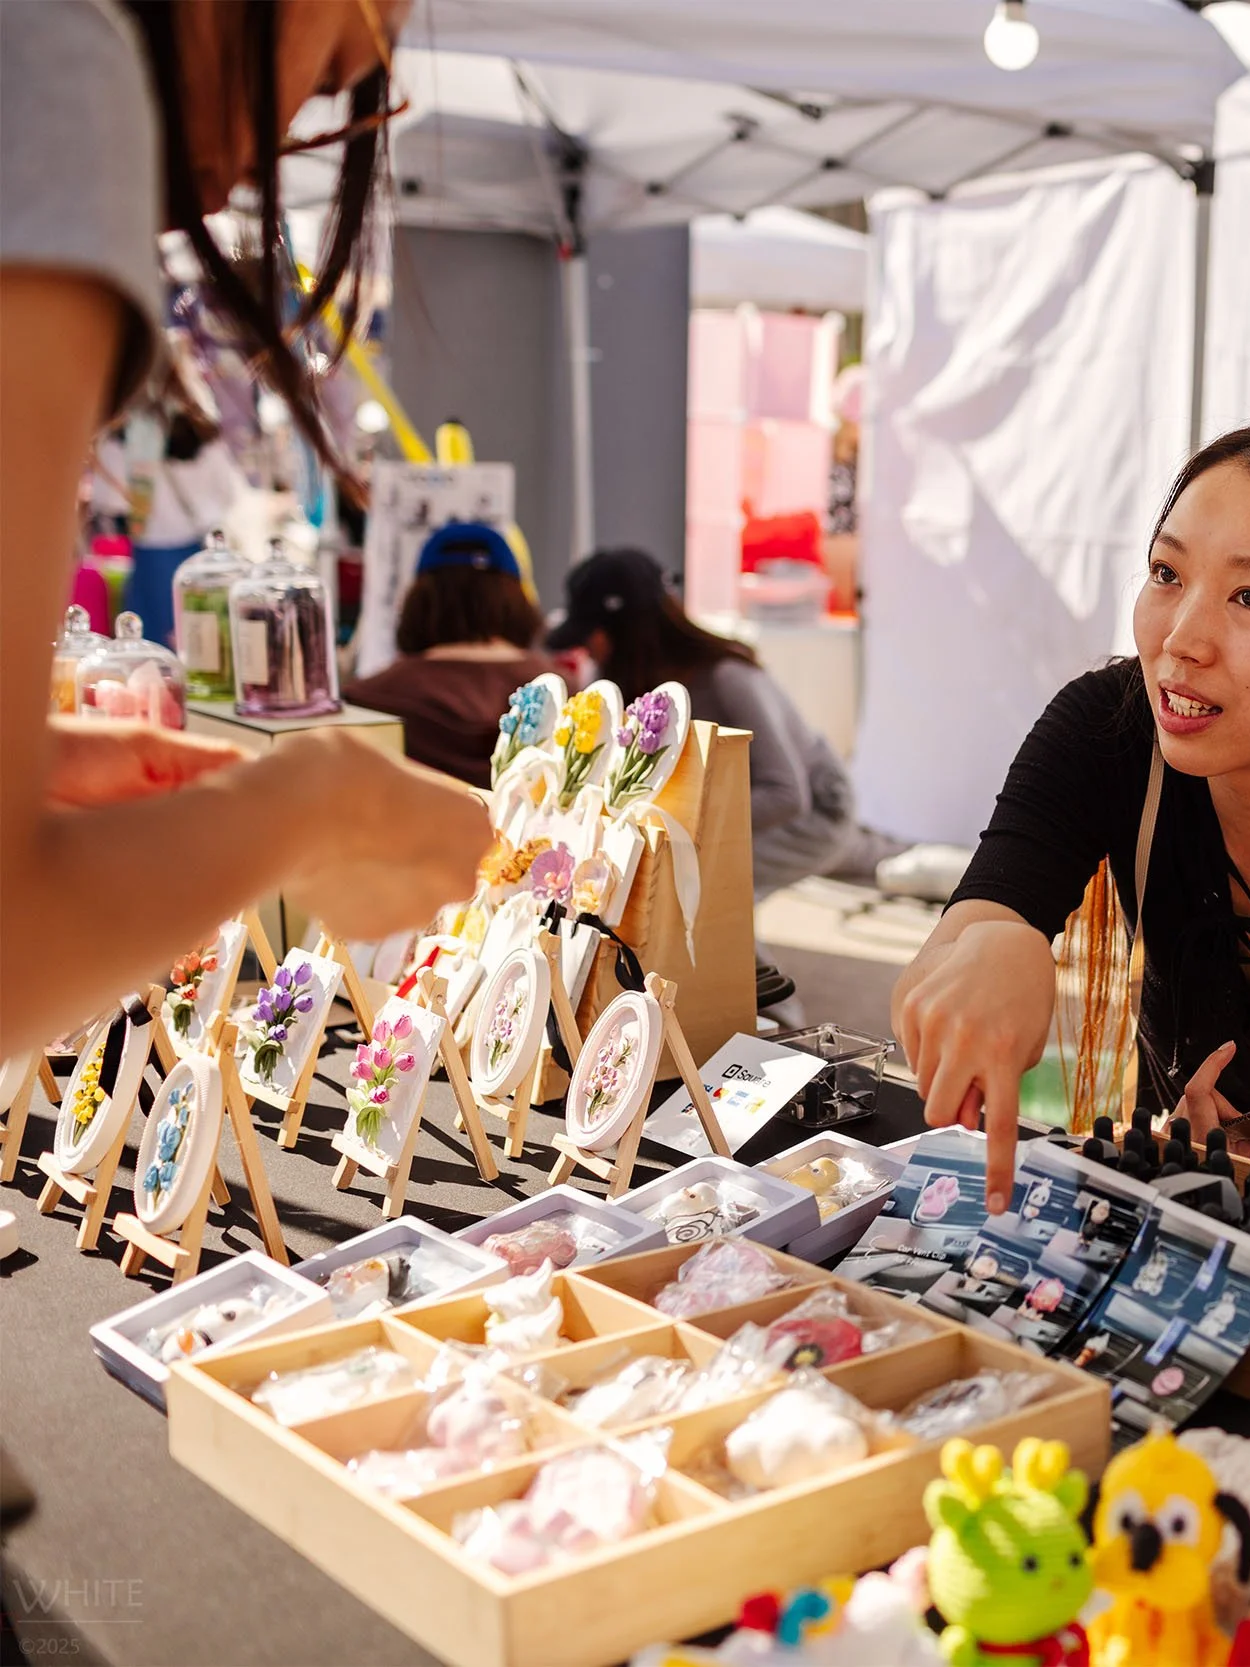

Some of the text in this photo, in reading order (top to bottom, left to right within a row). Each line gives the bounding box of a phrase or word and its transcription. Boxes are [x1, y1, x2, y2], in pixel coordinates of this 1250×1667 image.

[737, 1069, 772, 1088] Square
[897, 1244, 912, 1253] Car
[913, 1247, 931, 1256] Vent
